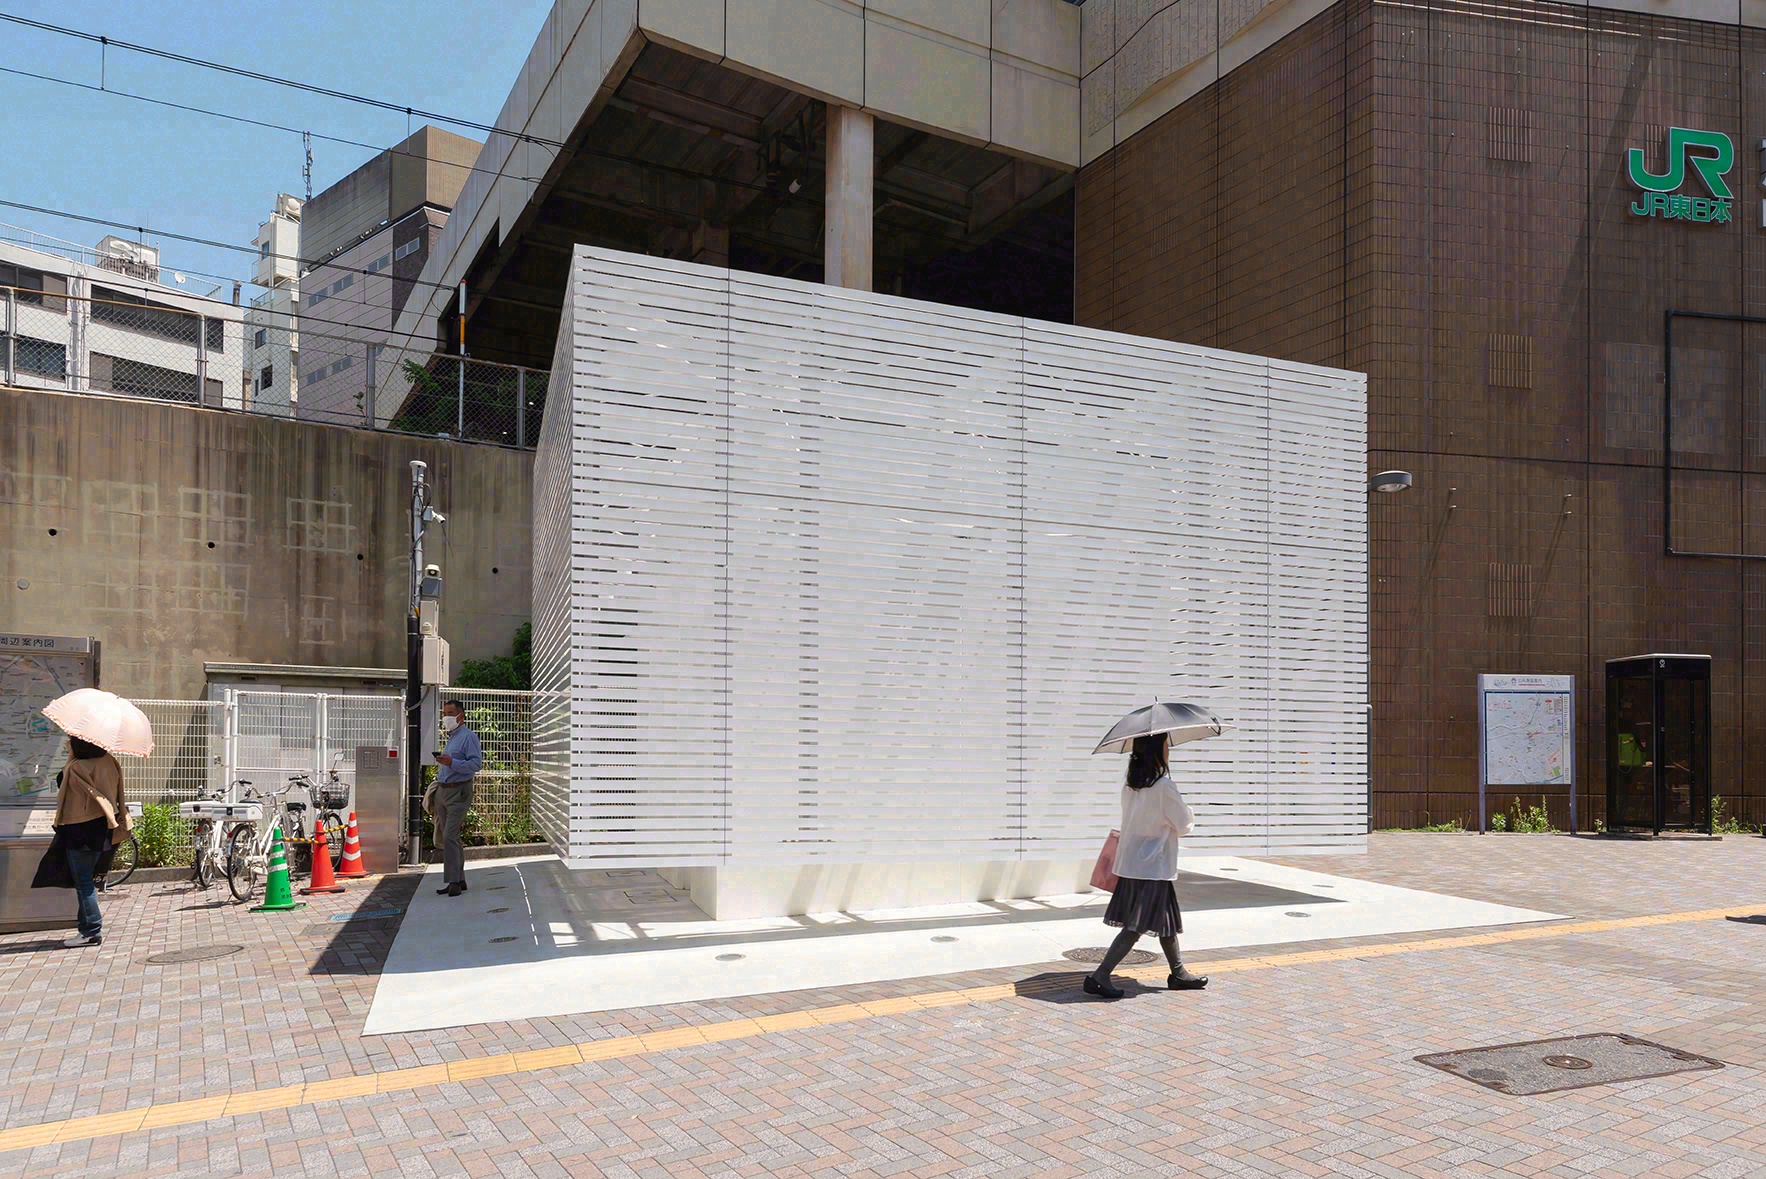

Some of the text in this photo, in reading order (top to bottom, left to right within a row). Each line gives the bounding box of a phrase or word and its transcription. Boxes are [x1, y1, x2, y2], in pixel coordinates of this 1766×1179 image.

[1628, 126, 1735, 199] JR
[1631, 191, 1733, 224] JR東日本
